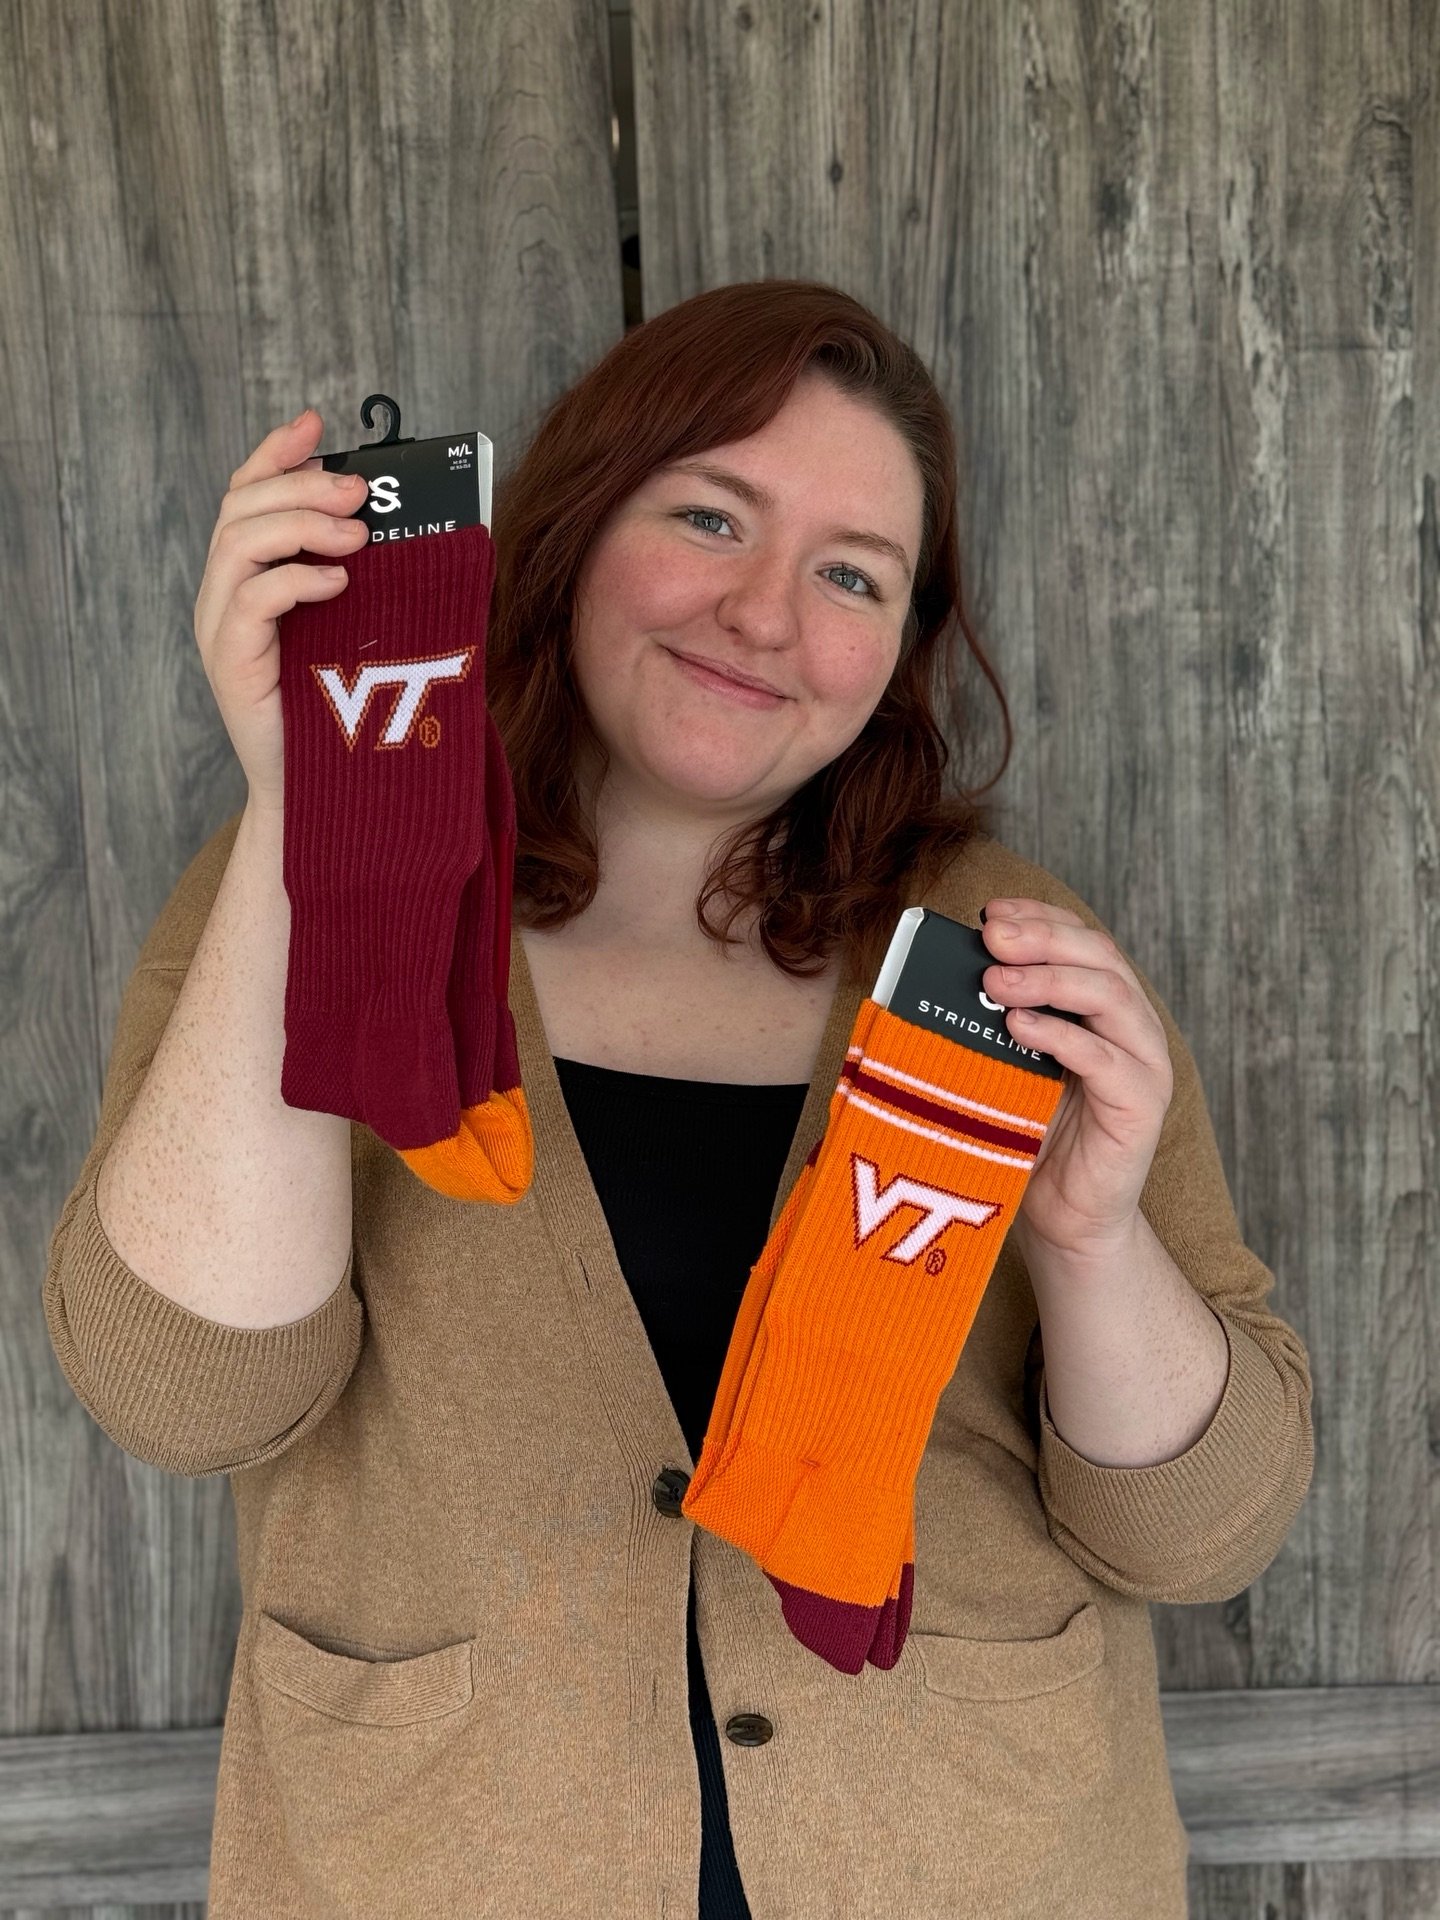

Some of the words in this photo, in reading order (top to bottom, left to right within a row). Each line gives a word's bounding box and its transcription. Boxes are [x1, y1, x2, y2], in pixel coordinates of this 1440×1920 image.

[448, 442, 473, 458] M/L
[372, 520, 457, 543] DELINE
[918, 1000, 1042, 1061] STRIDELINE
